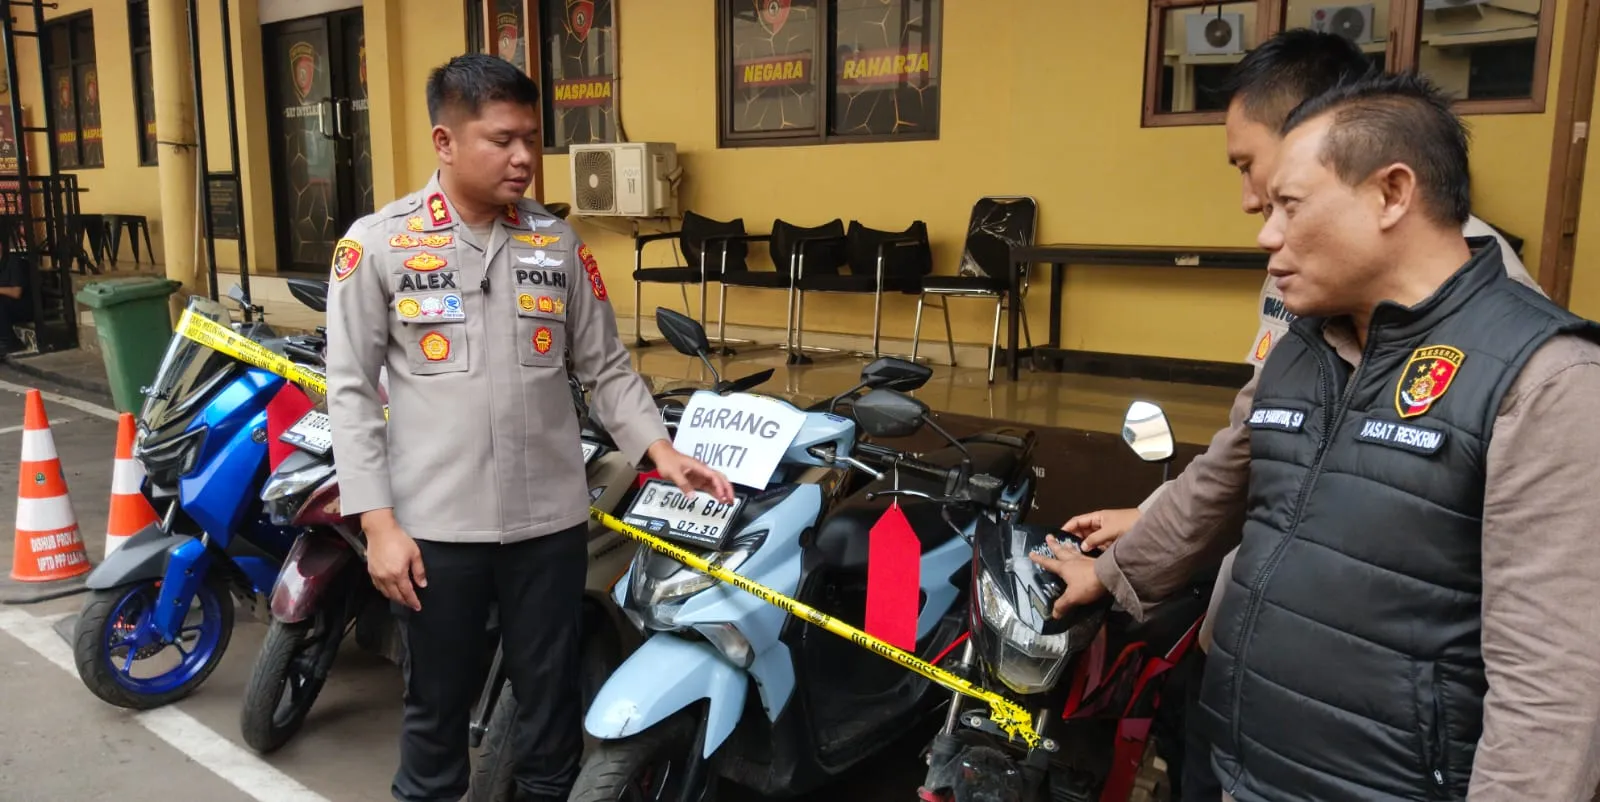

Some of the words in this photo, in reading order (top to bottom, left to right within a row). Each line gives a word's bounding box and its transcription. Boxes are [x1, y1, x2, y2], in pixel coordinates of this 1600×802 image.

[744, 61, 803, 82] NEGARA
[843, 52, 929, 79] RAHARJA
[555, 81, 611, 100] WASPADA
[400, 272, 456, 291] ALEX
[516, 270, 567, 288] POLRI
[690, 407, 780, 439] BARANG
[1360, 421, 1395, 440] KASAT
[1393, 425, 1441, 449] RESKRIM
[693, 443, 748, 469] BUKTI
[642, 487, 657, 505] B
[660, 491, 698, 513] 5004
[656, 542, 687, 563] CROSS
[733, 578, 768, 601] POLICE
[771, 595, 796, 614] LINE
[851, 631, 867, 648] DO
[871, 641, 895, 659] NOT
[897, 652, 938, 677] CROSS
